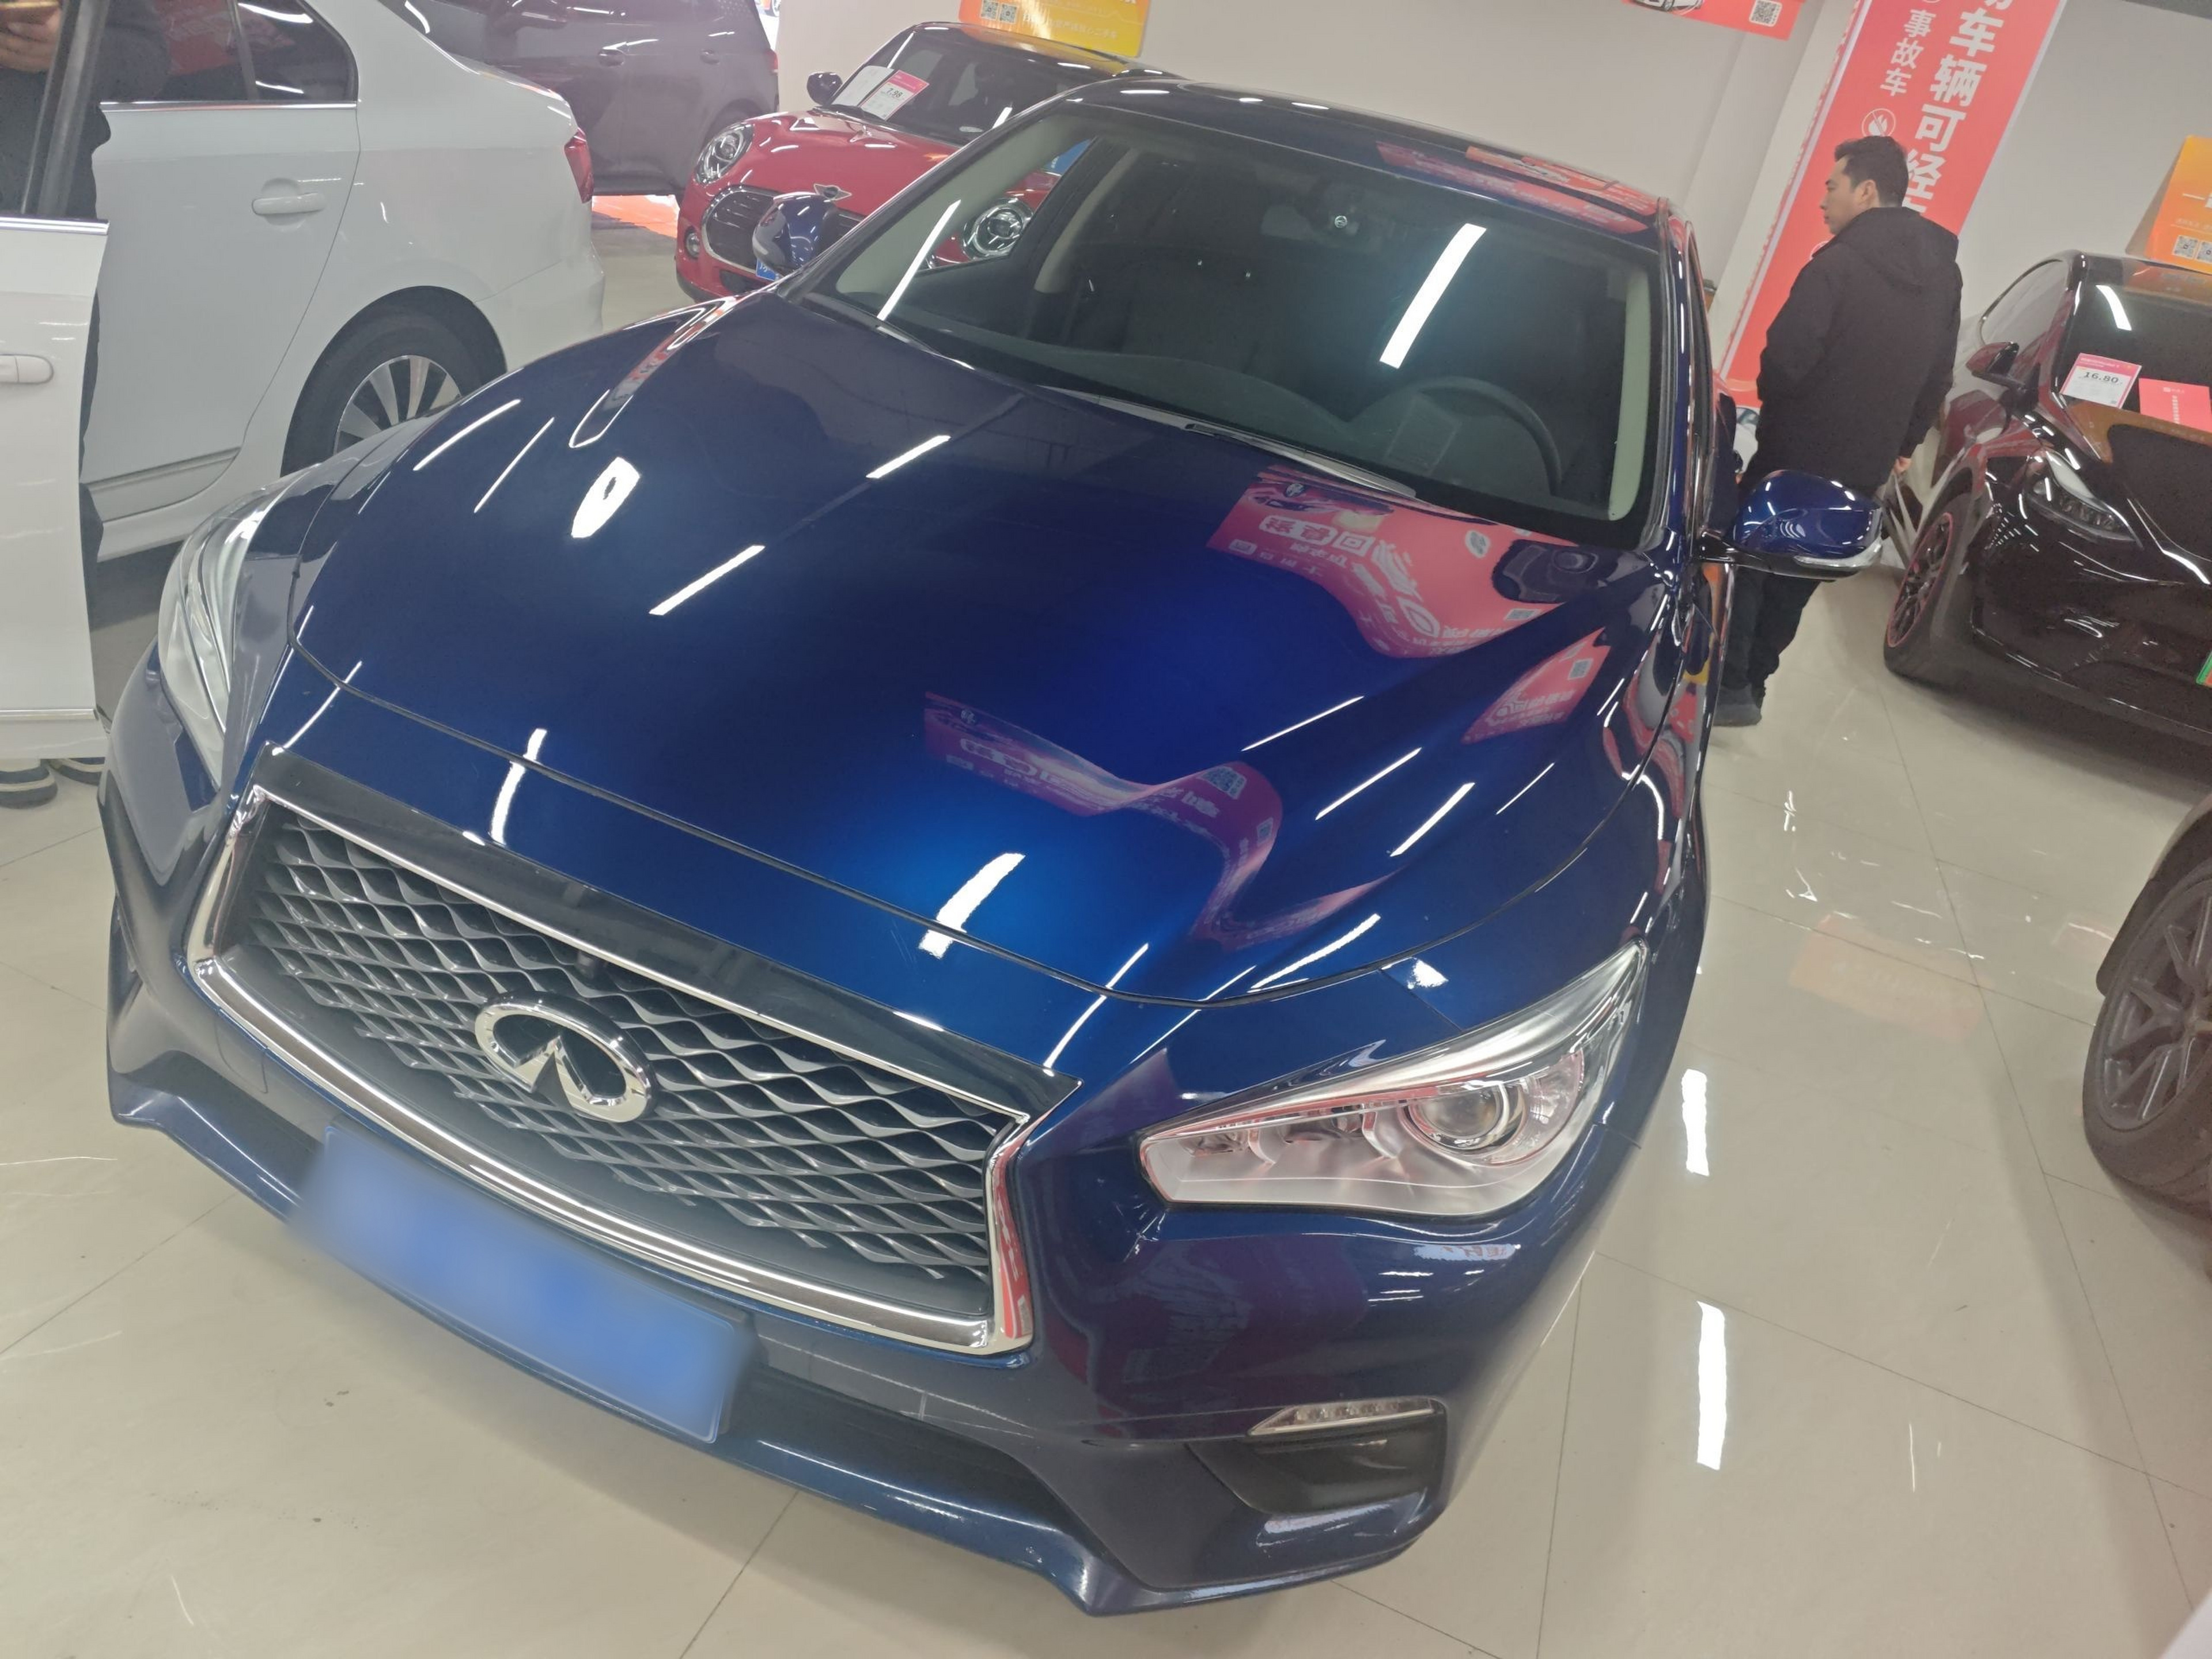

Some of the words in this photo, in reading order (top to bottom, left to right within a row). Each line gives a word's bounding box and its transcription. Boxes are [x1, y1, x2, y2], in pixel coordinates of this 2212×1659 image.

[1880, 9, 1937, 97] 事故车
[887, 88, 903, 98] 7.98
[2084, 372, 2119, 384] 16.80
